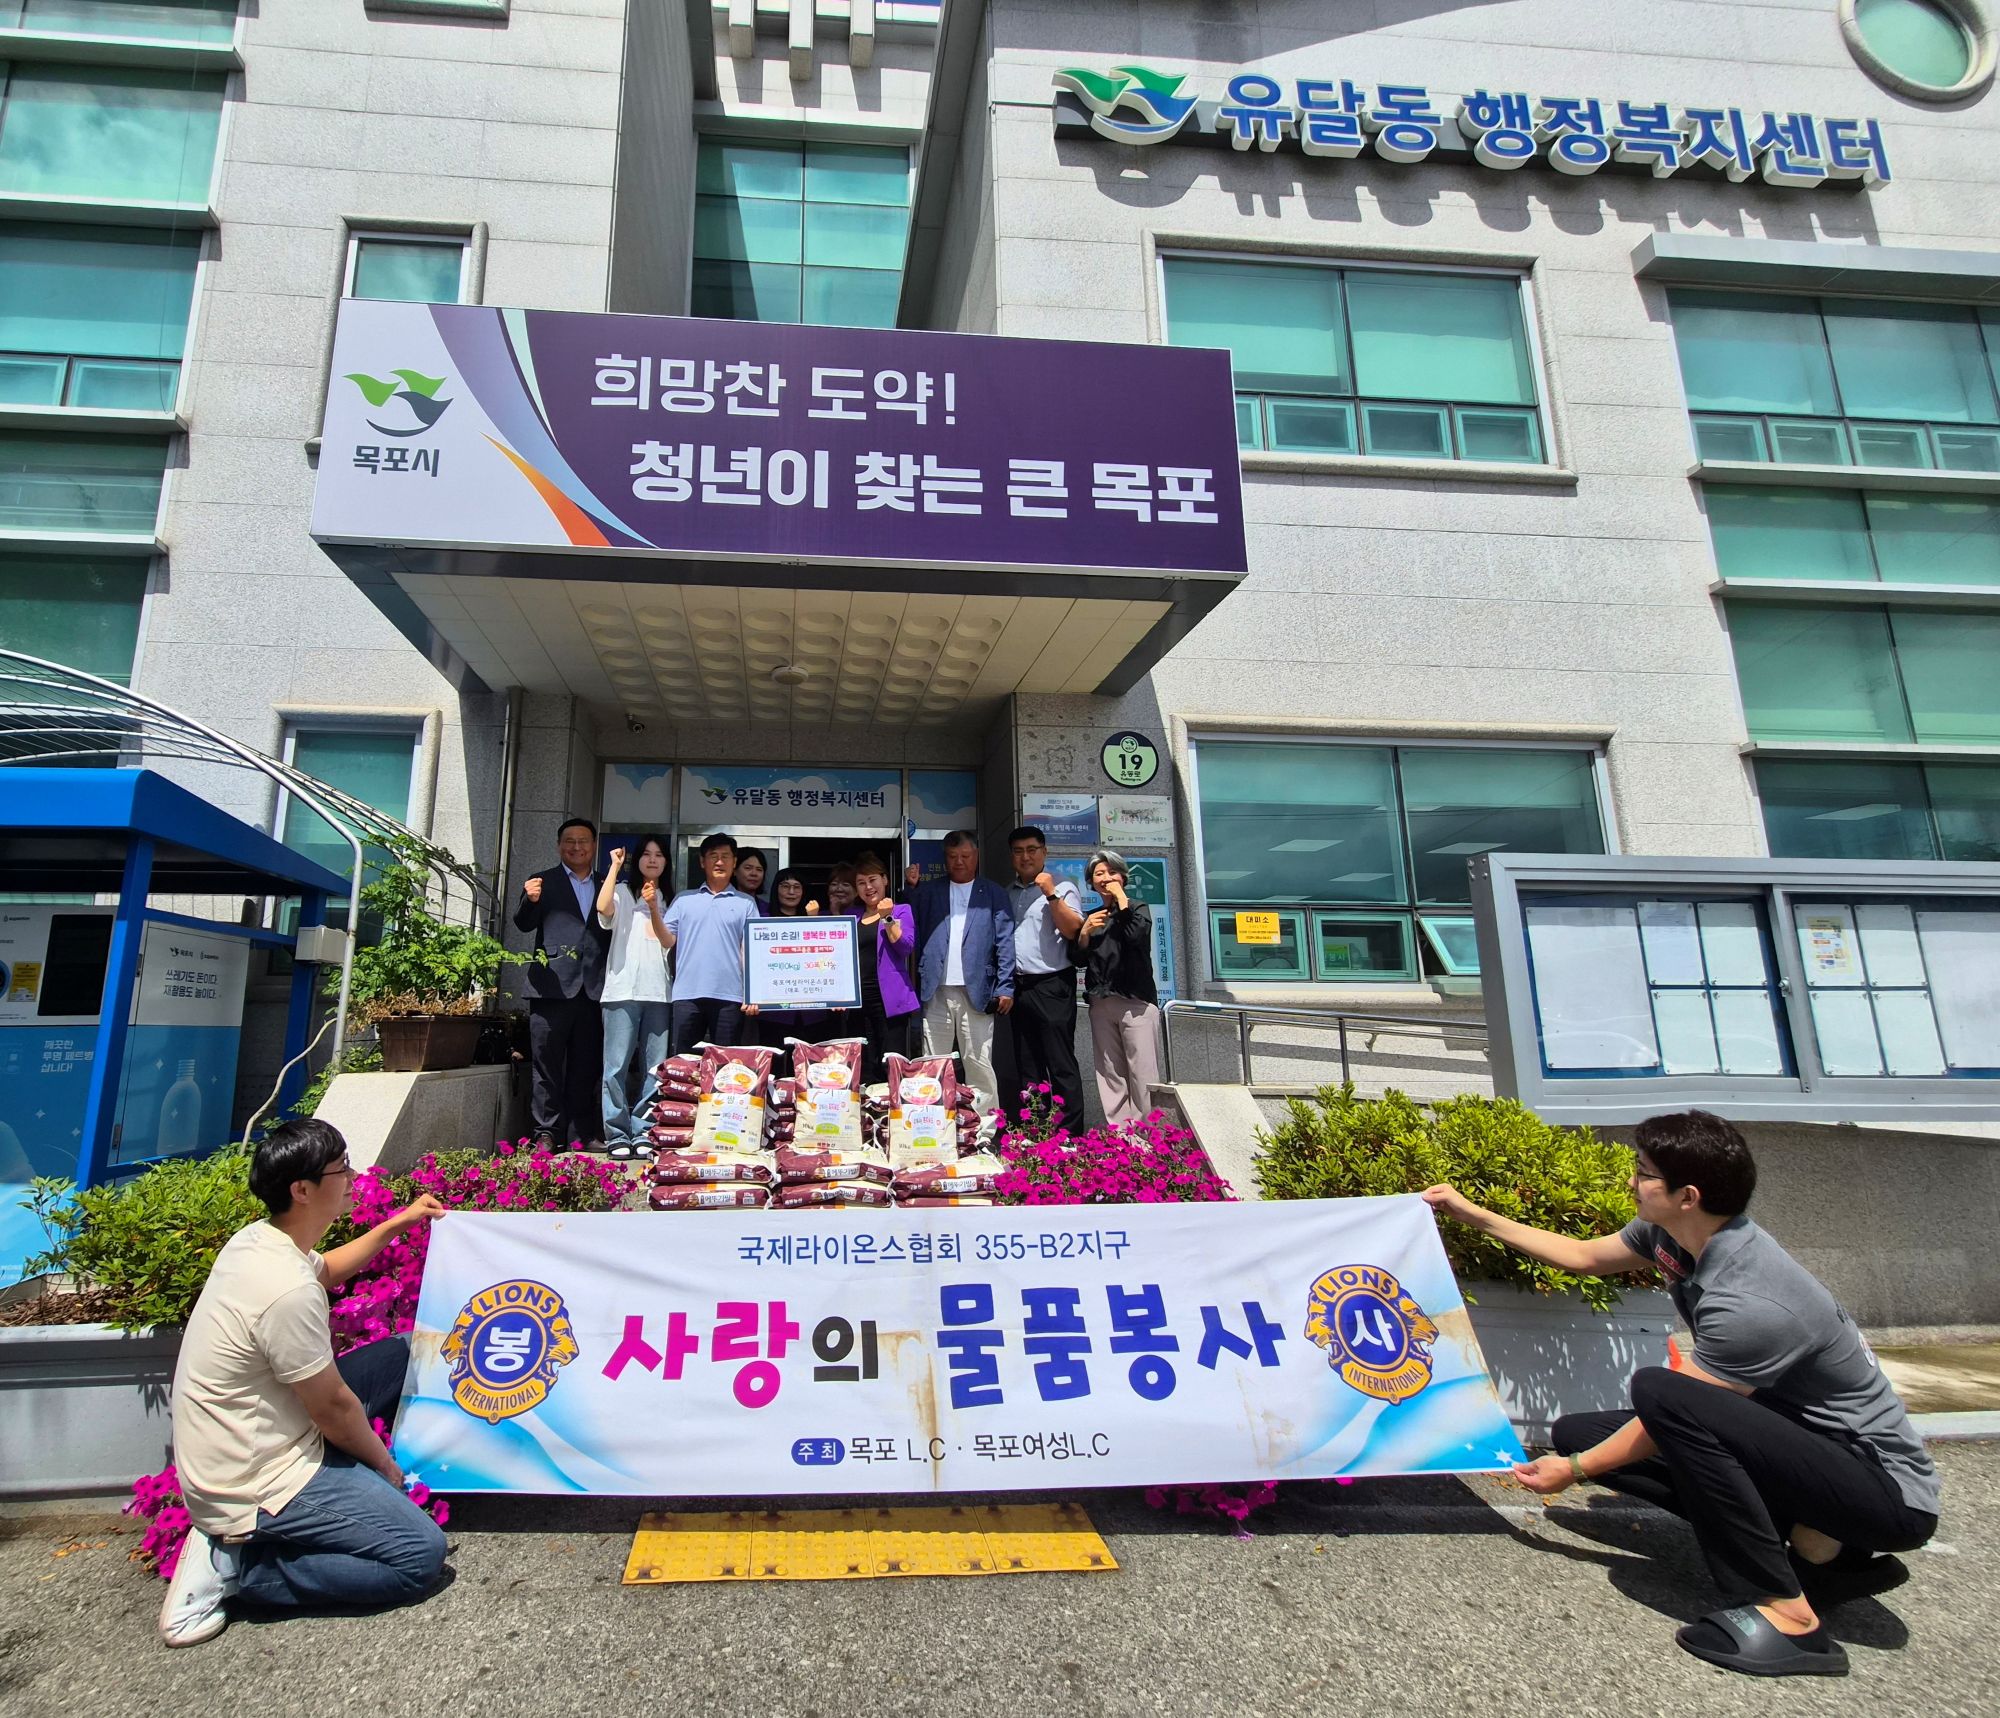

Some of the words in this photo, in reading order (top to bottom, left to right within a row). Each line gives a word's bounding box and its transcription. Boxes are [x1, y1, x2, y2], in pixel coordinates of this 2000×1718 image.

[1214, 73, 1443, 163] 유달동
[1457, 88, 1891, 192] 행정복지센터
[591, 353, 787, 417] 희망찬
[808, 366, 956, 425] 도약!
[352, 445, 440, 478] 목포시
[630, 440, 830, 508] 청년이
[855, 451, 983, 515] 찾는
[1007, 459, 1069, 518] 큰
[1092, 462, 1218, 524] 목포
[1118, 754, 1143, 770] 19
[732, 787, 783, 807] 유달동
[787, 788, 886, 808] 행정복지센터
[1156, 917, 1167, 947] 미세먼지
[1245, 915, 1270, 924] 대피소
[753, 930, 779, 941] 나눔의
[781, 930, 800, 941] 손길!
[802, 930, 827, 940] 행복한
[829, 930, 848, 940] 변화!
[163, 984, 194, 998] 재활용도
[165, 969, 195, 983] 쓰레기도
[42, 1051, 63, 1061] 투명
[64, 1051, 94, 1061] 페트병
[44, 1040, 74, 1050] 깨끗한
[737, 1231, 963, 1266] 국제라이온스협회
[975, 1229, 1132, 1262] 355-B2지구
[1316, 1266, 1396, 1300] LIONS
[475, 1282, 558, 1318] LIONS
[600, 1300, 880, 1409] 사랑의
[937, 1282, 1287, 1410] 물품봉사
[1350, 1308, 1398, 1353] 사
[483, 1325, 532, 1373] 봉
[1347, 1364, 1427, 1395] INTERNATIONAL
[459, 1383, 542, 1413] INTERNATIONAL
[849, 1436, 899, 1463] 목포
[907, 1437, 947, 1463] L.C
[972, 1432, 1111, 1462] 목포여성L.C
